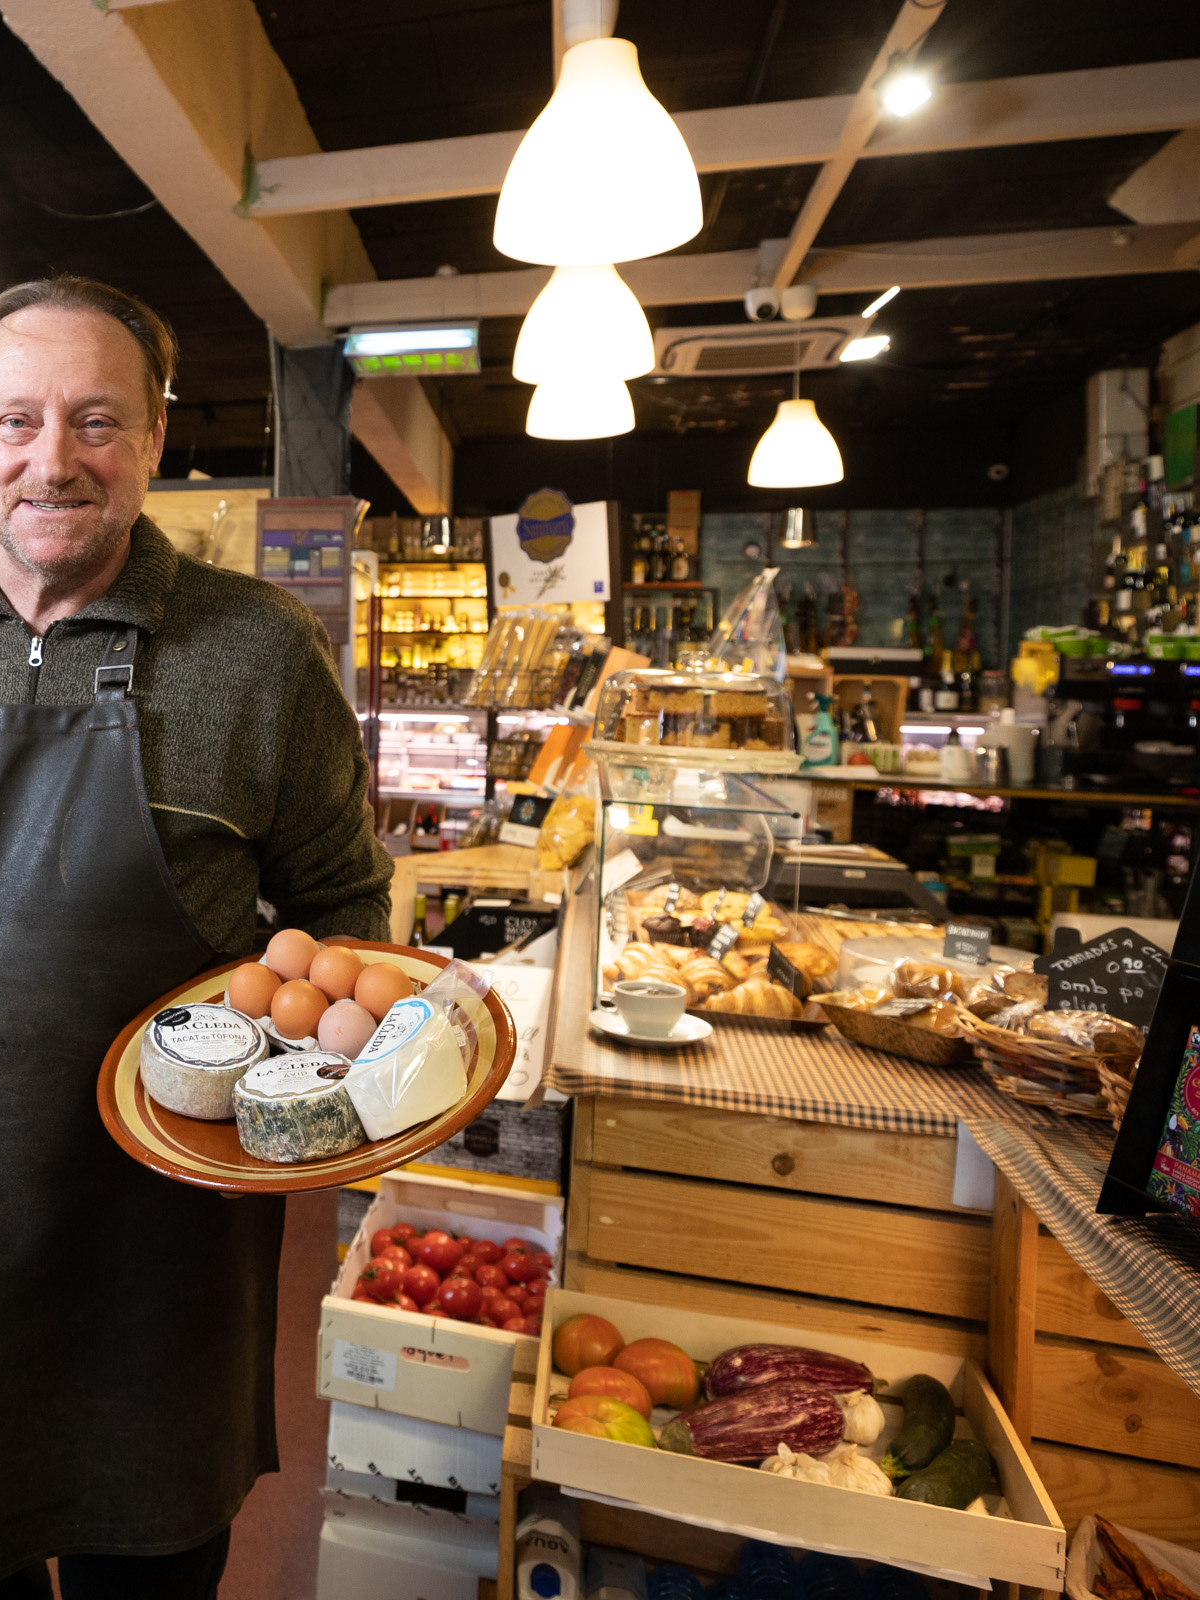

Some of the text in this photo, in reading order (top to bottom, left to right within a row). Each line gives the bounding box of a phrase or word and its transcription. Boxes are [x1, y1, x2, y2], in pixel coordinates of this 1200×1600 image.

[1059, 978, 1144, 1004] amb pa
[172, 1021, 242, 1032] LA CLEDA
[368, 1012, 401, 1053] LA CLEDA
[171, 1034, 200, 1043] TACAT
